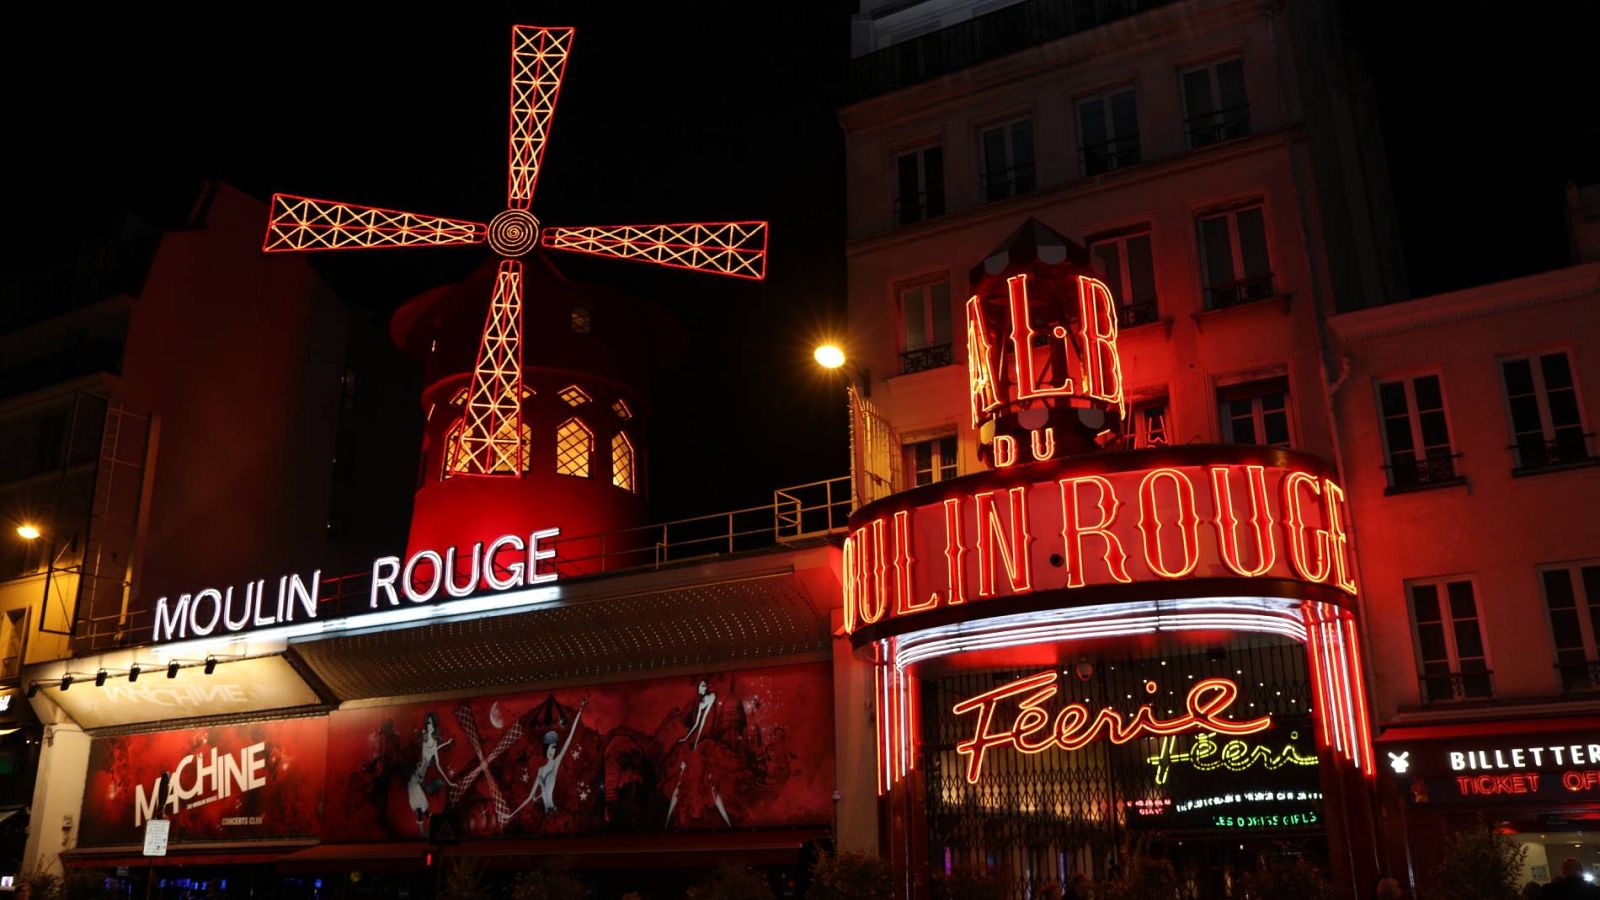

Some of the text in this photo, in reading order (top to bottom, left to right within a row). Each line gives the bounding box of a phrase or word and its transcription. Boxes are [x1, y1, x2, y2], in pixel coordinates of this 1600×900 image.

[993, 428, 1055, 467] DU
[1060, 466, 1357, 595] ROUGE
[152, 527, 560, 641] MOULIN ROUGE
[953, 671, 1271, 784] Féerie
[1450, 744, 1600, 771] BILLETTER
[135, 741, 267, 828] MACHINE
[1457, 771, 1600, 796] TICKET OF
